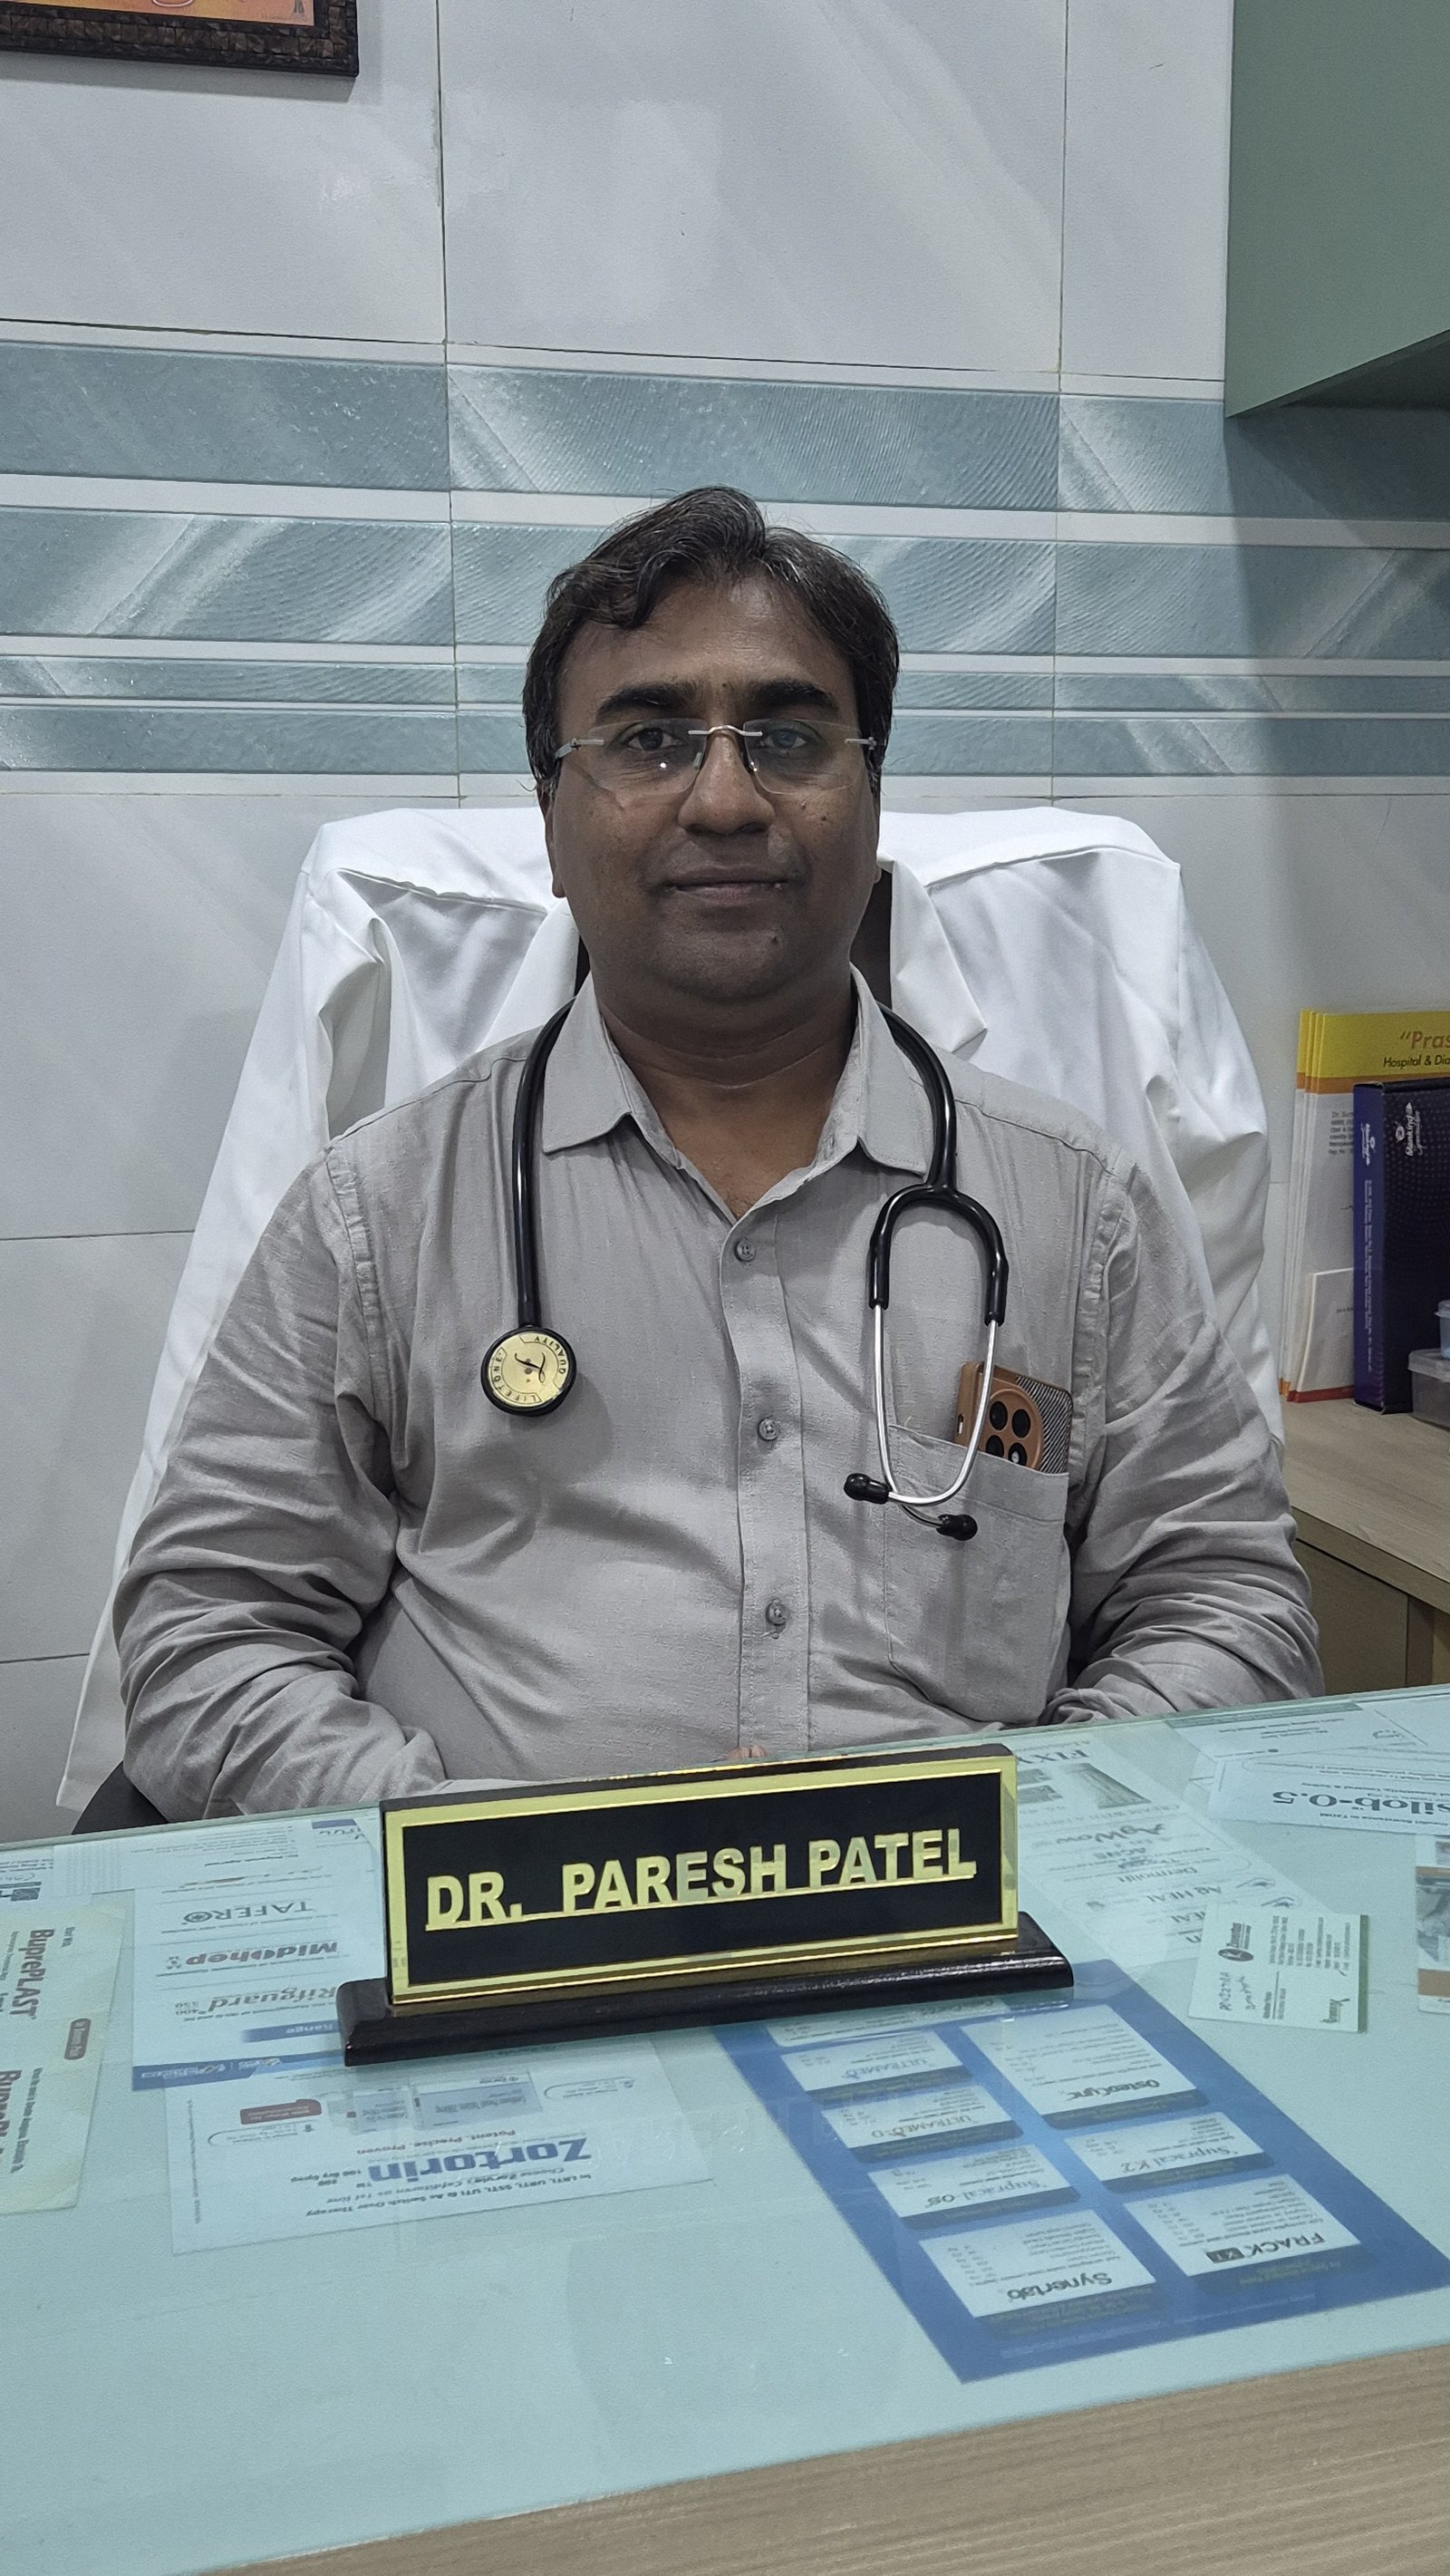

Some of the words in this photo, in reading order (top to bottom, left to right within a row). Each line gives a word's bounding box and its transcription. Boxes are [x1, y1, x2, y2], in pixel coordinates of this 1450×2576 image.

[1383, 1055, 1421, 1070] Hospital
[1424, 1055, 1431, 1066] &
[535, 1336, 566, 1374] QUALITY
[427, 1872, 522, 1926] DR.
[562, 1843, 787, 1914] PARESH
[808, 1828, 977, 1890] PATEL
[9, 1929, 55, 2016] BuprePLAST
[208, 1987, 335, 2013] Rifguard
[357, 2145, 406, 2155] Proven
[367, 2137, 592, 2184] Zortorin
